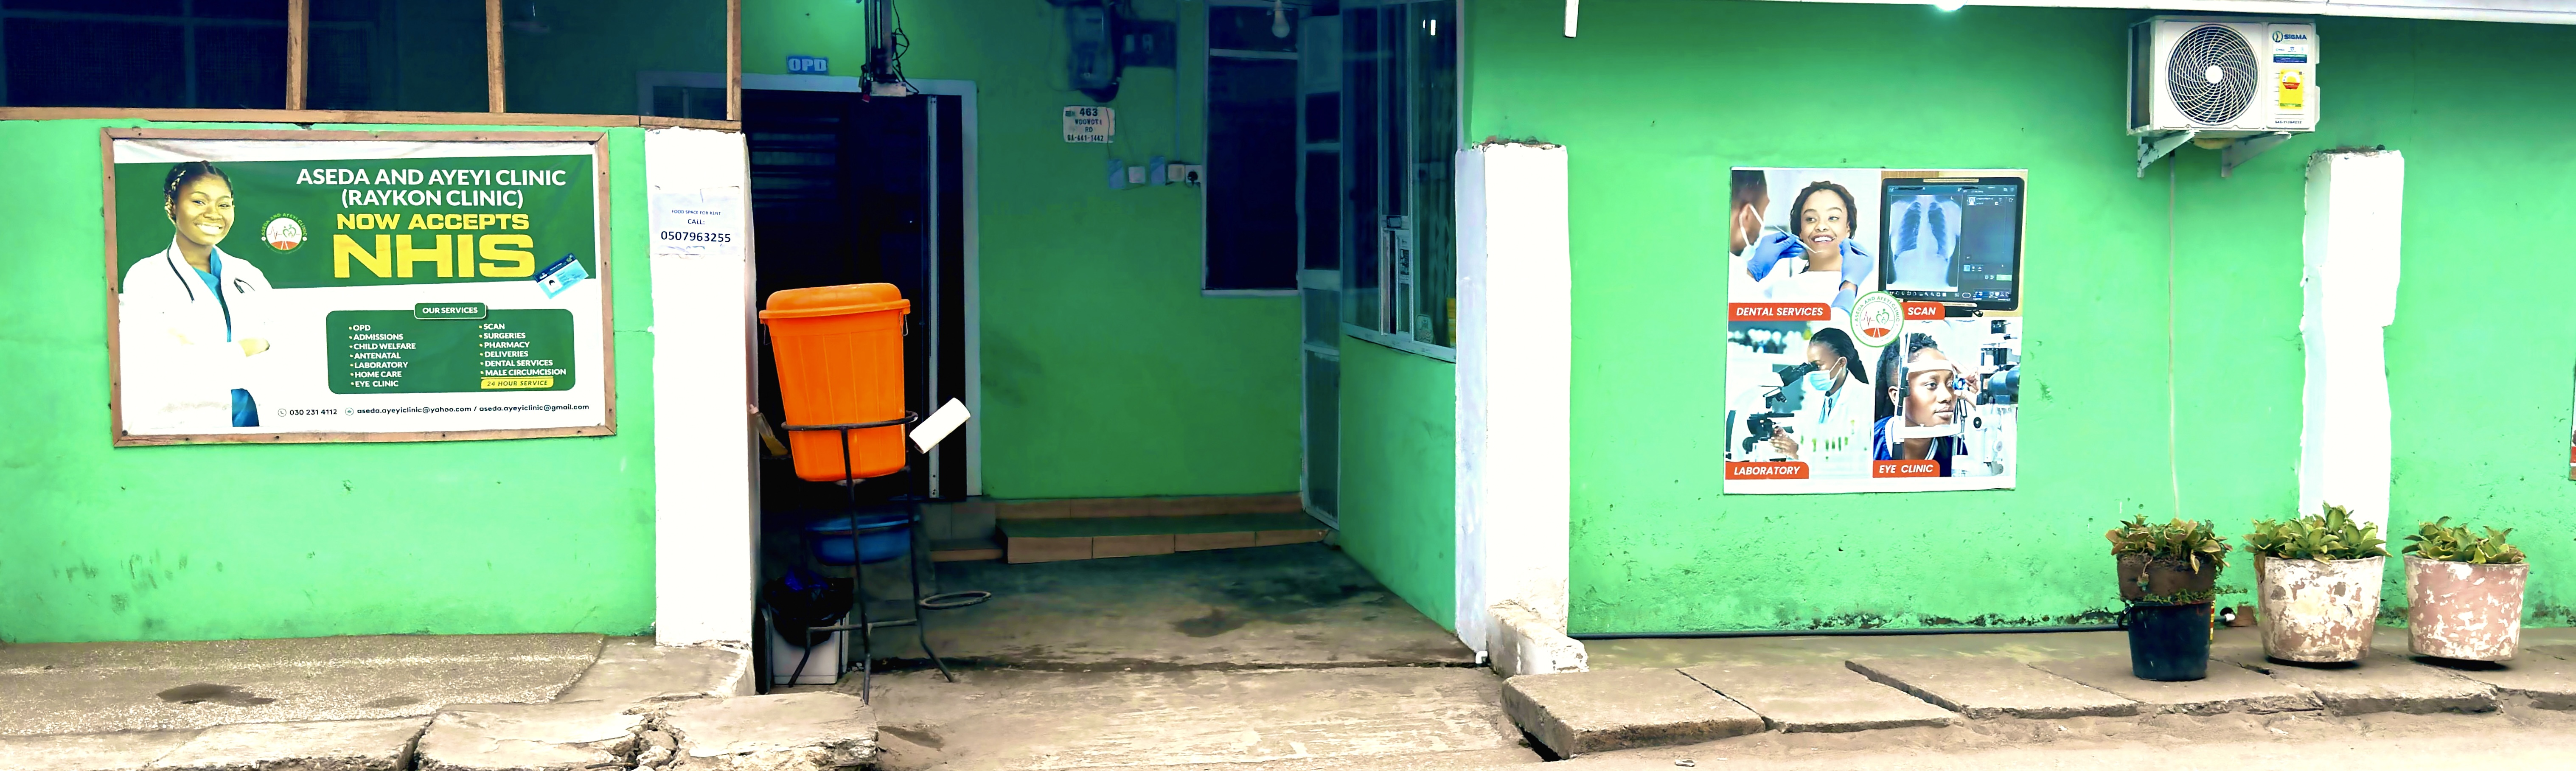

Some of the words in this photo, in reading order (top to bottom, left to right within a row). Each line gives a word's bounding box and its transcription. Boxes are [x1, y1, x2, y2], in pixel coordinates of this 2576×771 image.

[788, 58, 827, 71] OPD
[1080, 108, 1098, 116] 463
[296, 169, 370, 185] ASEDA
[374, 169, 424, 185] AND
[428, 169, 490, 186] AYEYI
[495, 169, 566, 186] CLINIC
[342, 189, 441, 209] (RAYKON
[446, 189, 524, 209] CLINIC)
[337, 213, 400, 230] NOW
[408, 213, 529, 230] ACCEPTS
[661, 231, 731, 242] 0507963255
[334, 234, 535, 278] NHIS
[1736, 307, 1774, 317] DENTAL
[1776, 307, 1824, 316] SERVICES
[1855, 304, 1864, 322] ASEDA
[1877, 296, 1892, 304] AYEYI
[1891, 303, 1900, 322] CLINIC
[1908, 307, 1936, 316] SCAN
[357, 406, 471, 415] aseda.ayeyiclinic@yahoo.com
[479, 404, 589, 412] aseda.ayeyiclinic@gmail.com
[1734, 466, 1800, 476] LABORATORY
[1879, 465, 1898, 473] EYE
[1901, 464, 1933, 473] CLINIC
